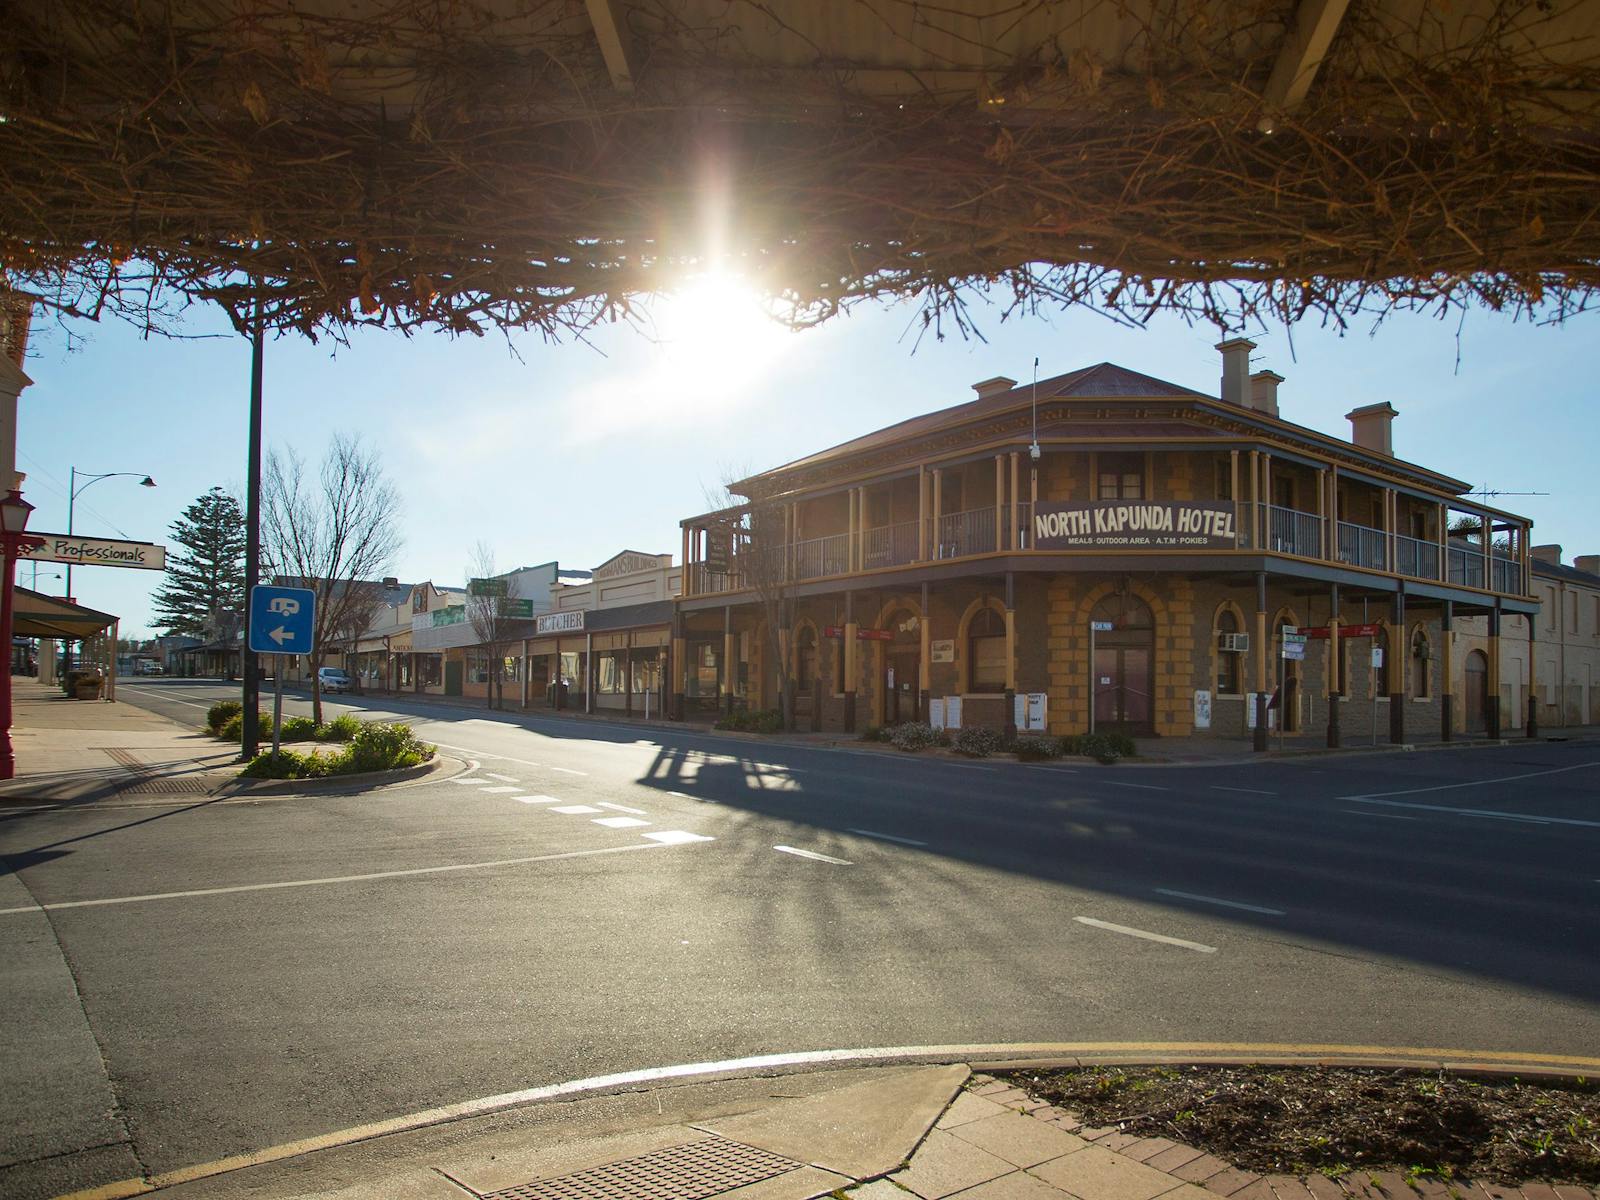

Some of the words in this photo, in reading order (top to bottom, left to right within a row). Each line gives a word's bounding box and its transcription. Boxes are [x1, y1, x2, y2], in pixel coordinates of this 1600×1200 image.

[1035, 510, 1091, 539] NORTH
[1094, 505, 1173, 533] KAPUNDA
[1176, 507, 1235, 538] HOTEL
[55, 541, 145, 562] Professionals
[539, 612, 582, 631] BUTCHER
